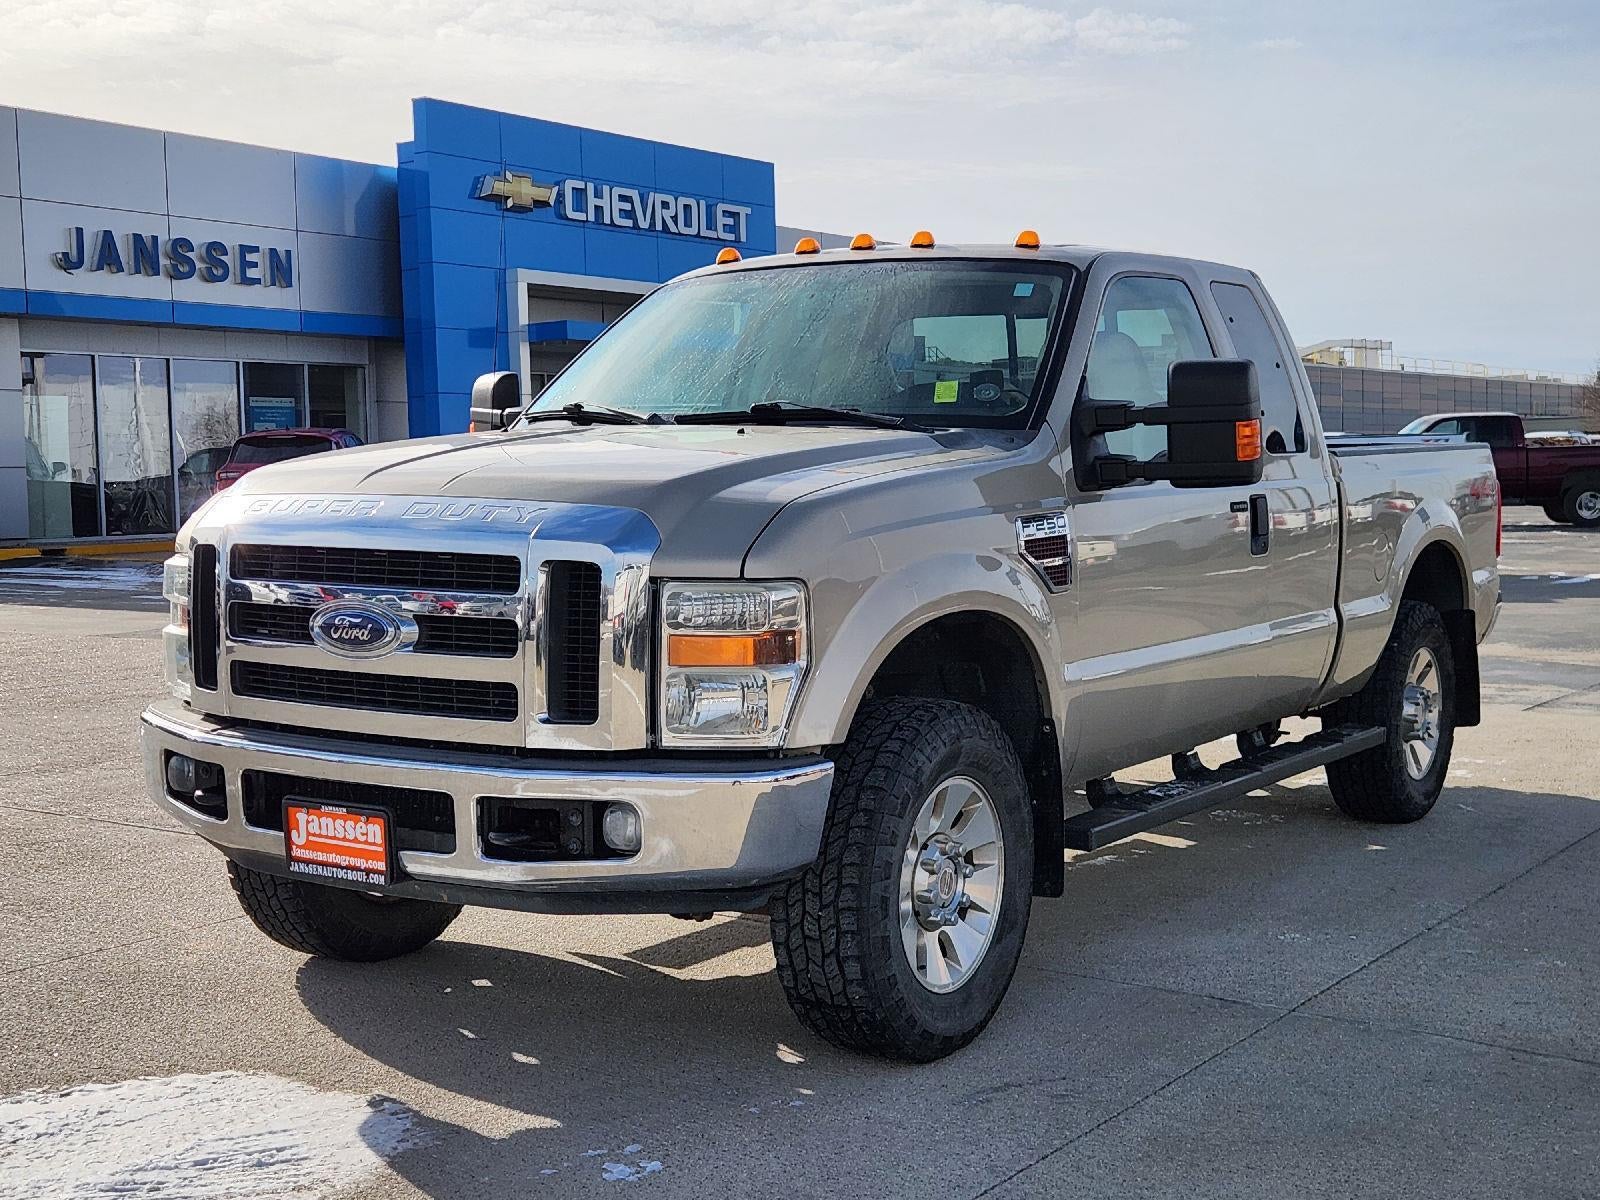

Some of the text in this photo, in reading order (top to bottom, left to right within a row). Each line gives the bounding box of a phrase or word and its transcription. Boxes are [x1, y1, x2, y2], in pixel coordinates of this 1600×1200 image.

[564, 178, 751, 243] CHEVROLET
[54, 226, 293, 288] JANSSEN
[248, 499, 547, 524] SUPER DUTY
[330, 615, 373, 641] Ford
[291, 812, 382, 845] Janssen
[291, 845, 386, 870] Janssenautogroup.com
